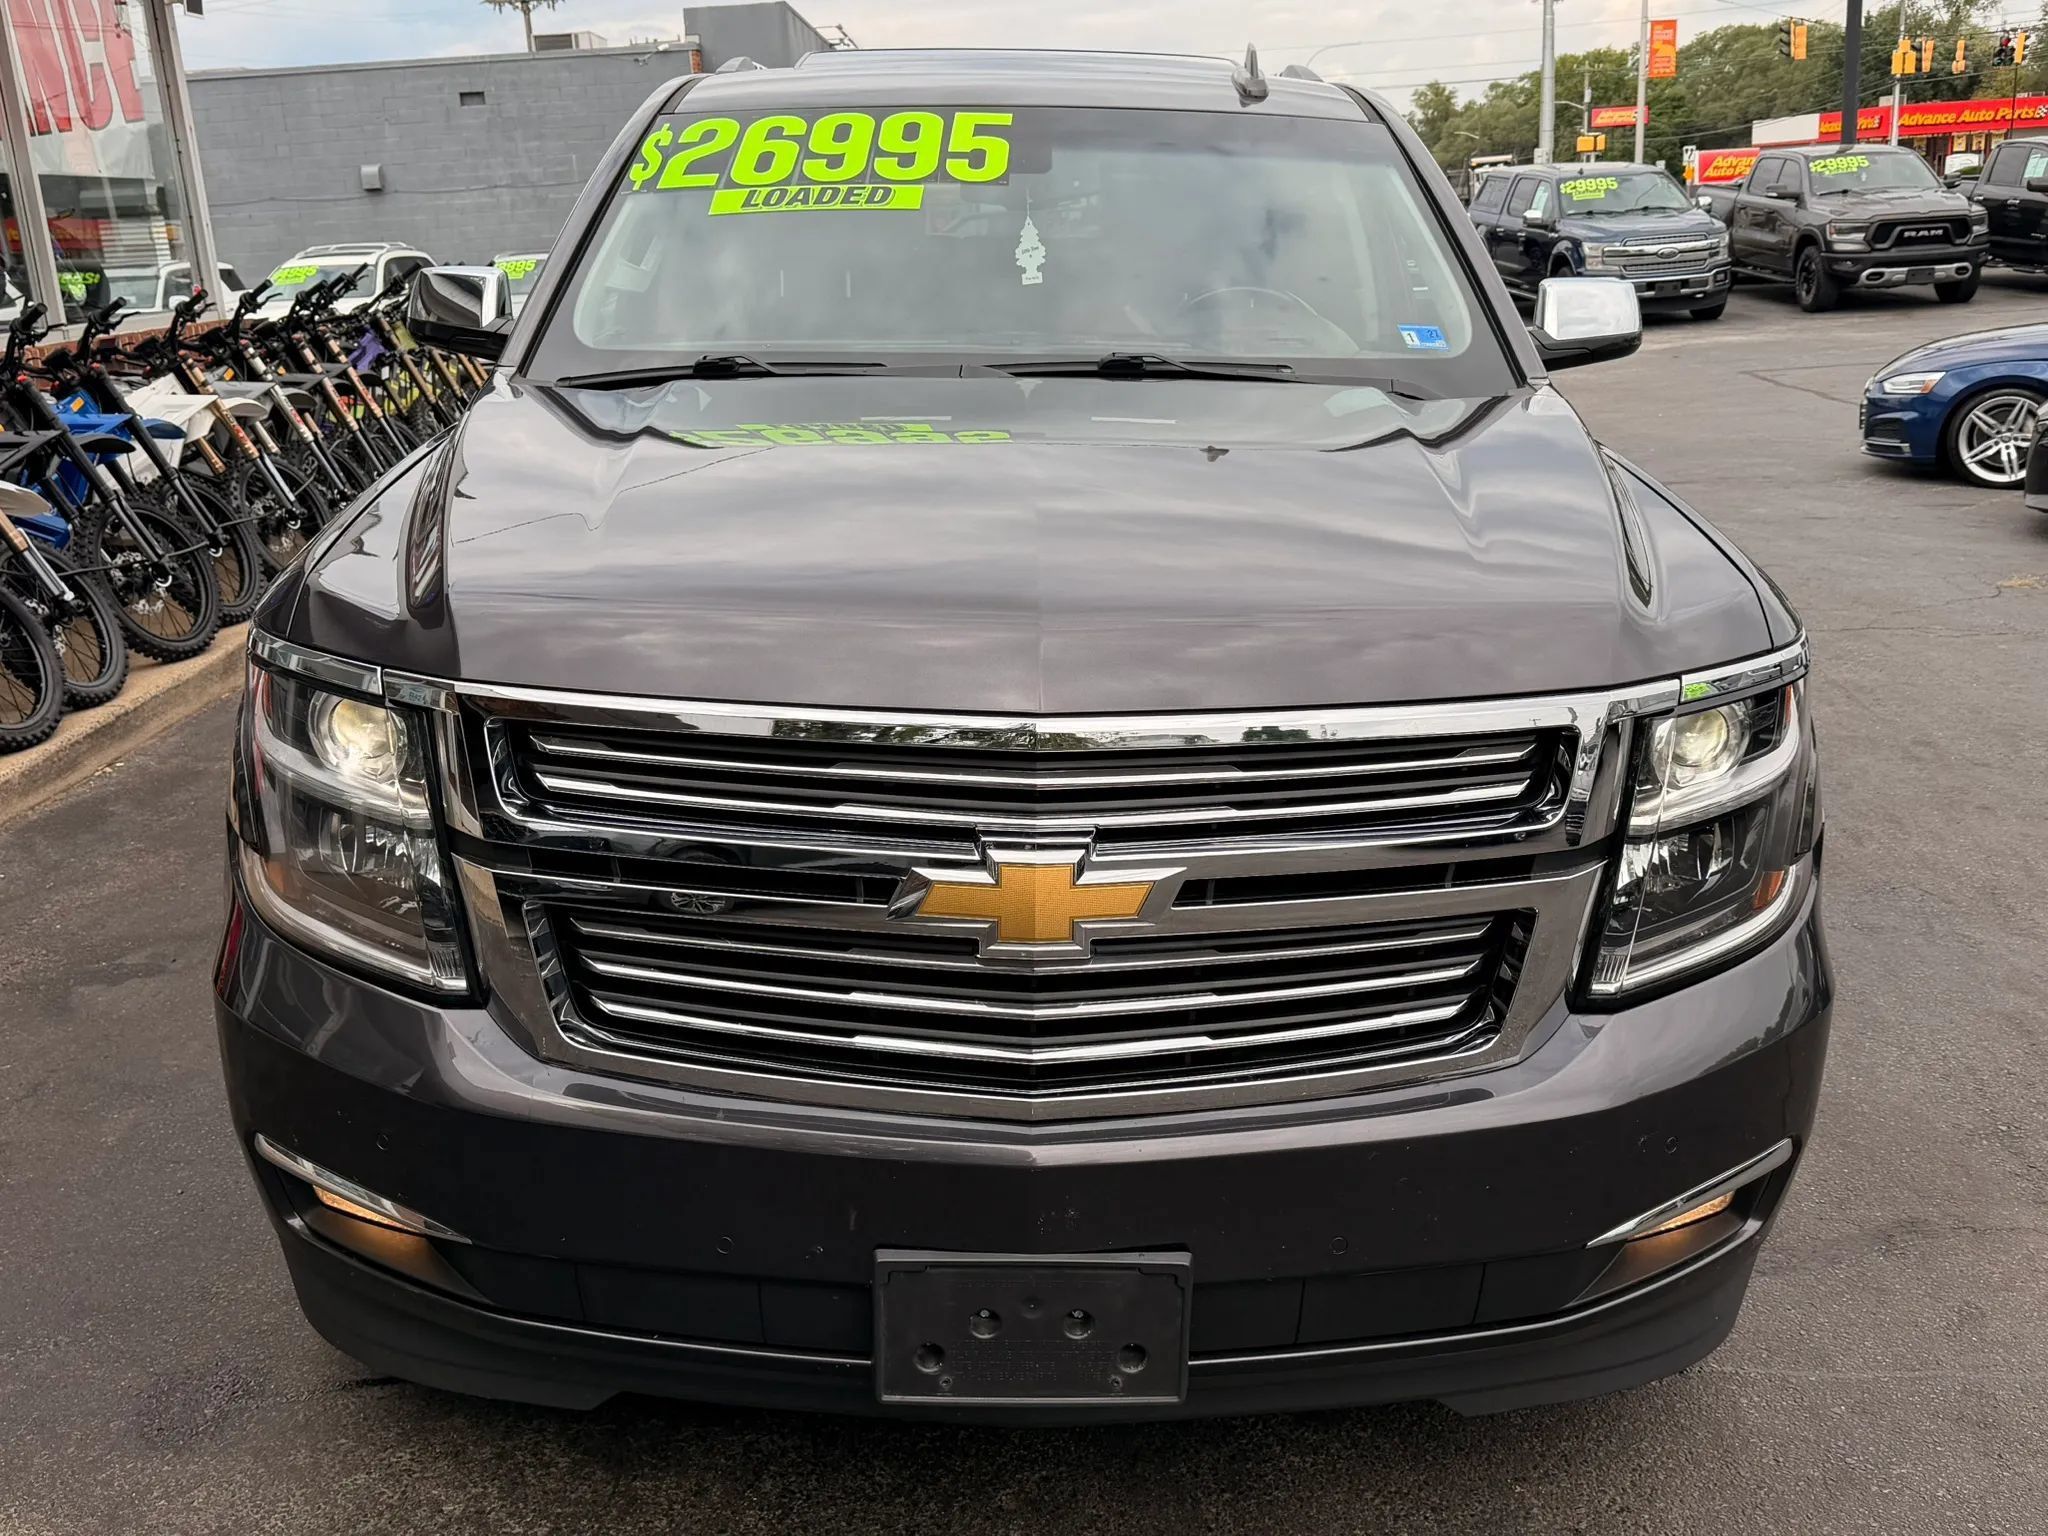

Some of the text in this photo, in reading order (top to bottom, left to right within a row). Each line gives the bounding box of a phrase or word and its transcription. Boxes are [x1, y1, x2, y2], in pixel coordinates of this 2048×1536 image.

[1899, 106, 2036, 126] Advance Auto Parts
[628, 111, 1014, 191] $26995
[1713, 155, 1755, 168] Advan
[1703, 167, 1735, 177] Auto
[1560, 176, 1619, 195] $29995
[739, 185, 897, 210] LOADED
[1903, 228, 1944, 238] RAM
